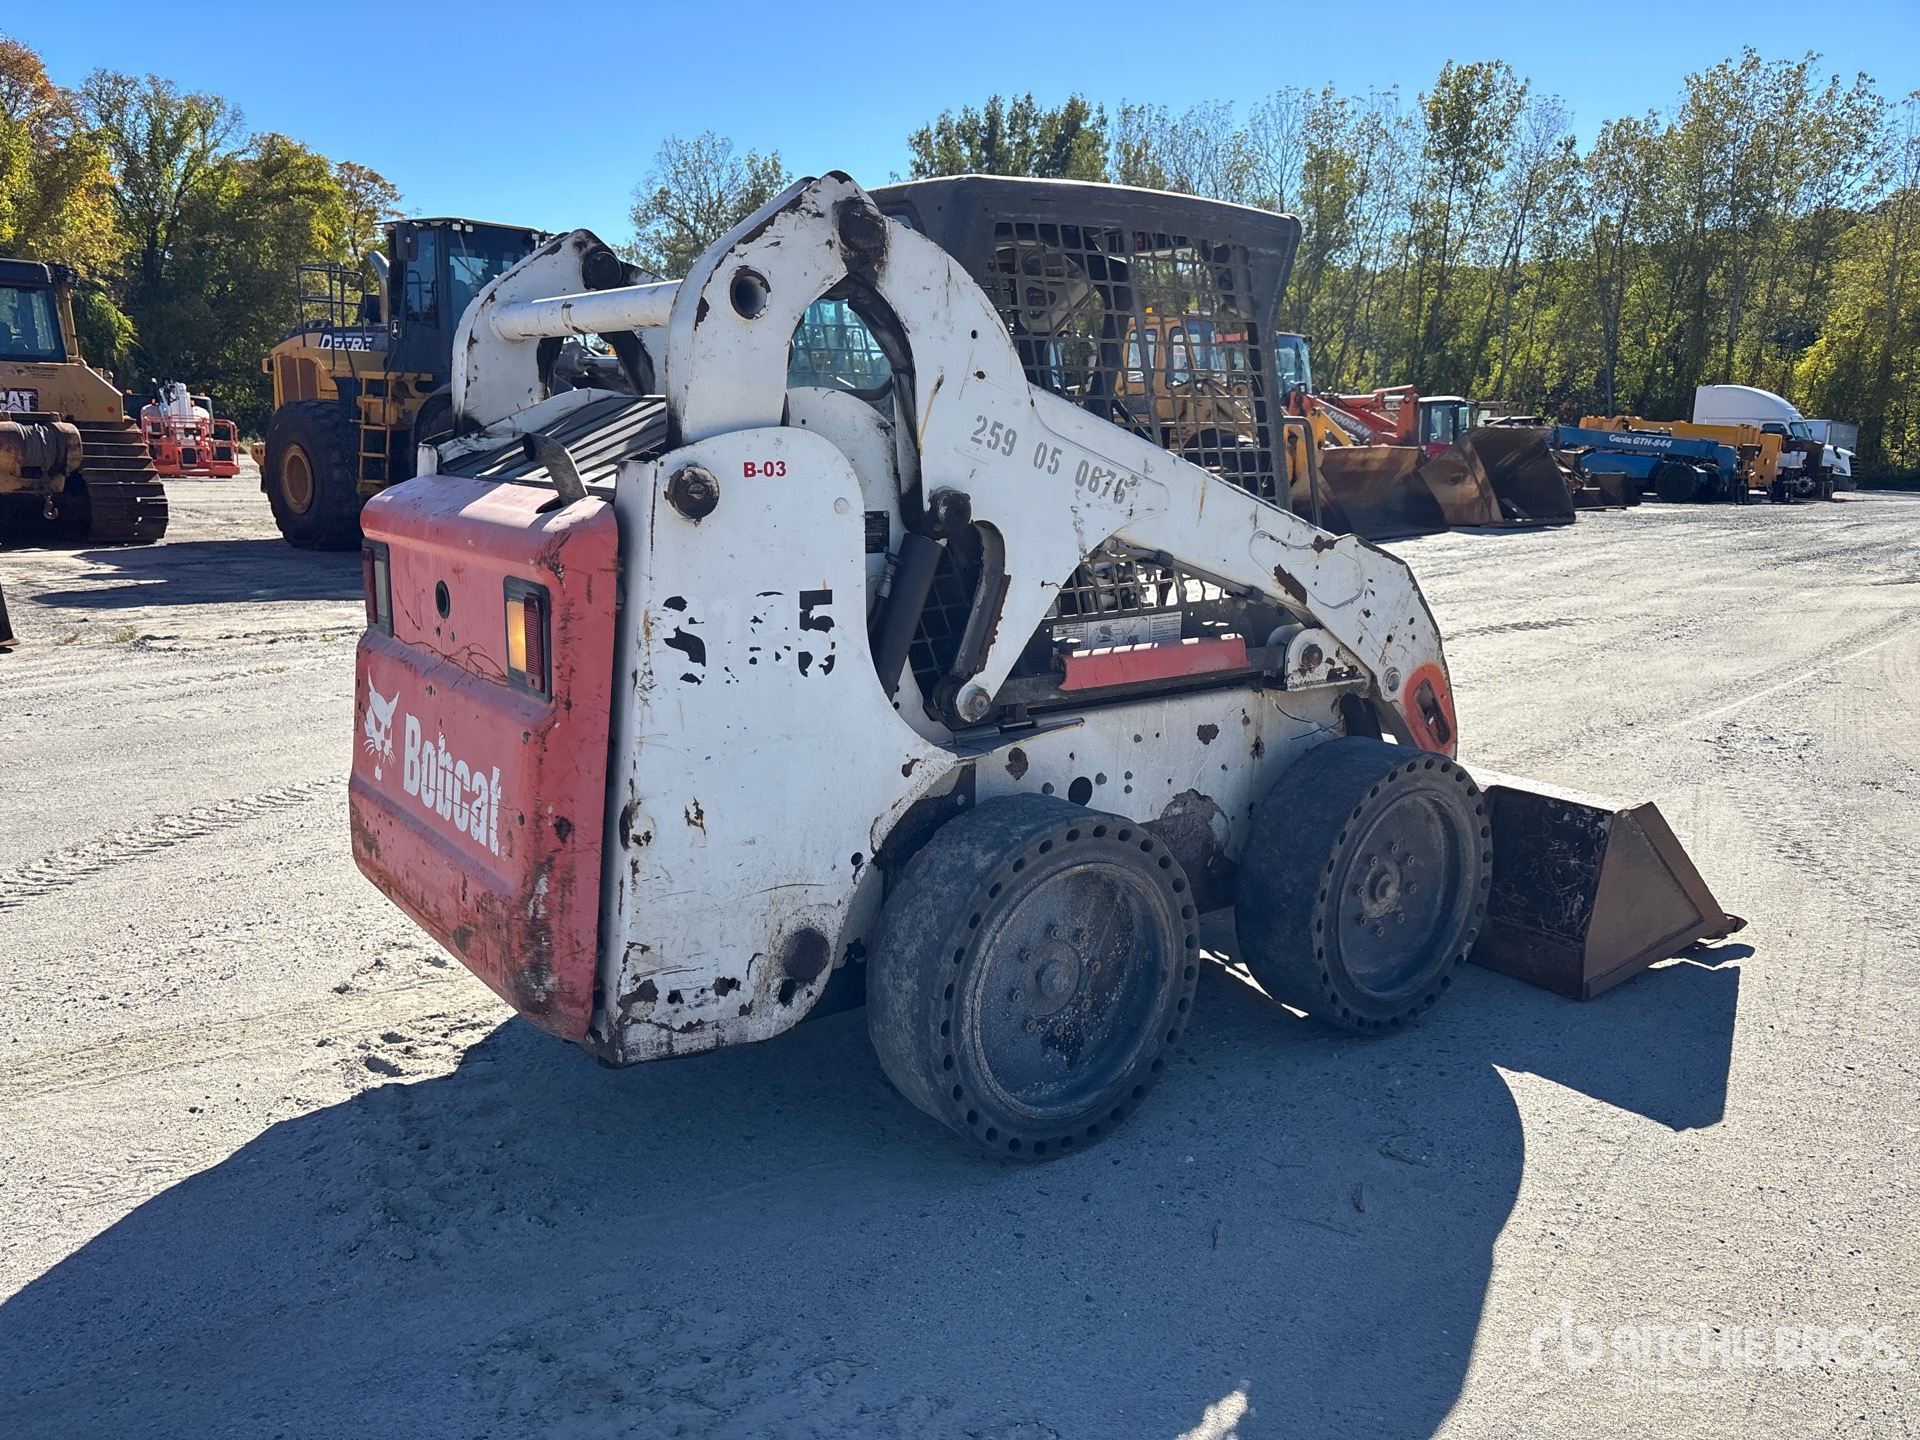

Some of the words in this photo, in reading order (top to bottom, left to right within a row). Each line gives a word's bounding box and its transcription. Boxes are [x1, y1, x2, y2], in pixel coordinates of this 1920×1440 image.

[320, 334, 373, 351] DEERE
[1329, 410, 1372, 436] DOOSAN
[970, 414, 1018, 457] 259
[1033, 441, 1063, 475] 05
[1609, 434, 1632, 445] Genie
[1633, 437, 1673, 448] GTH-844
[743, 460, 787, 478] B-03
[403, 712, 502, 857] Bobcat
